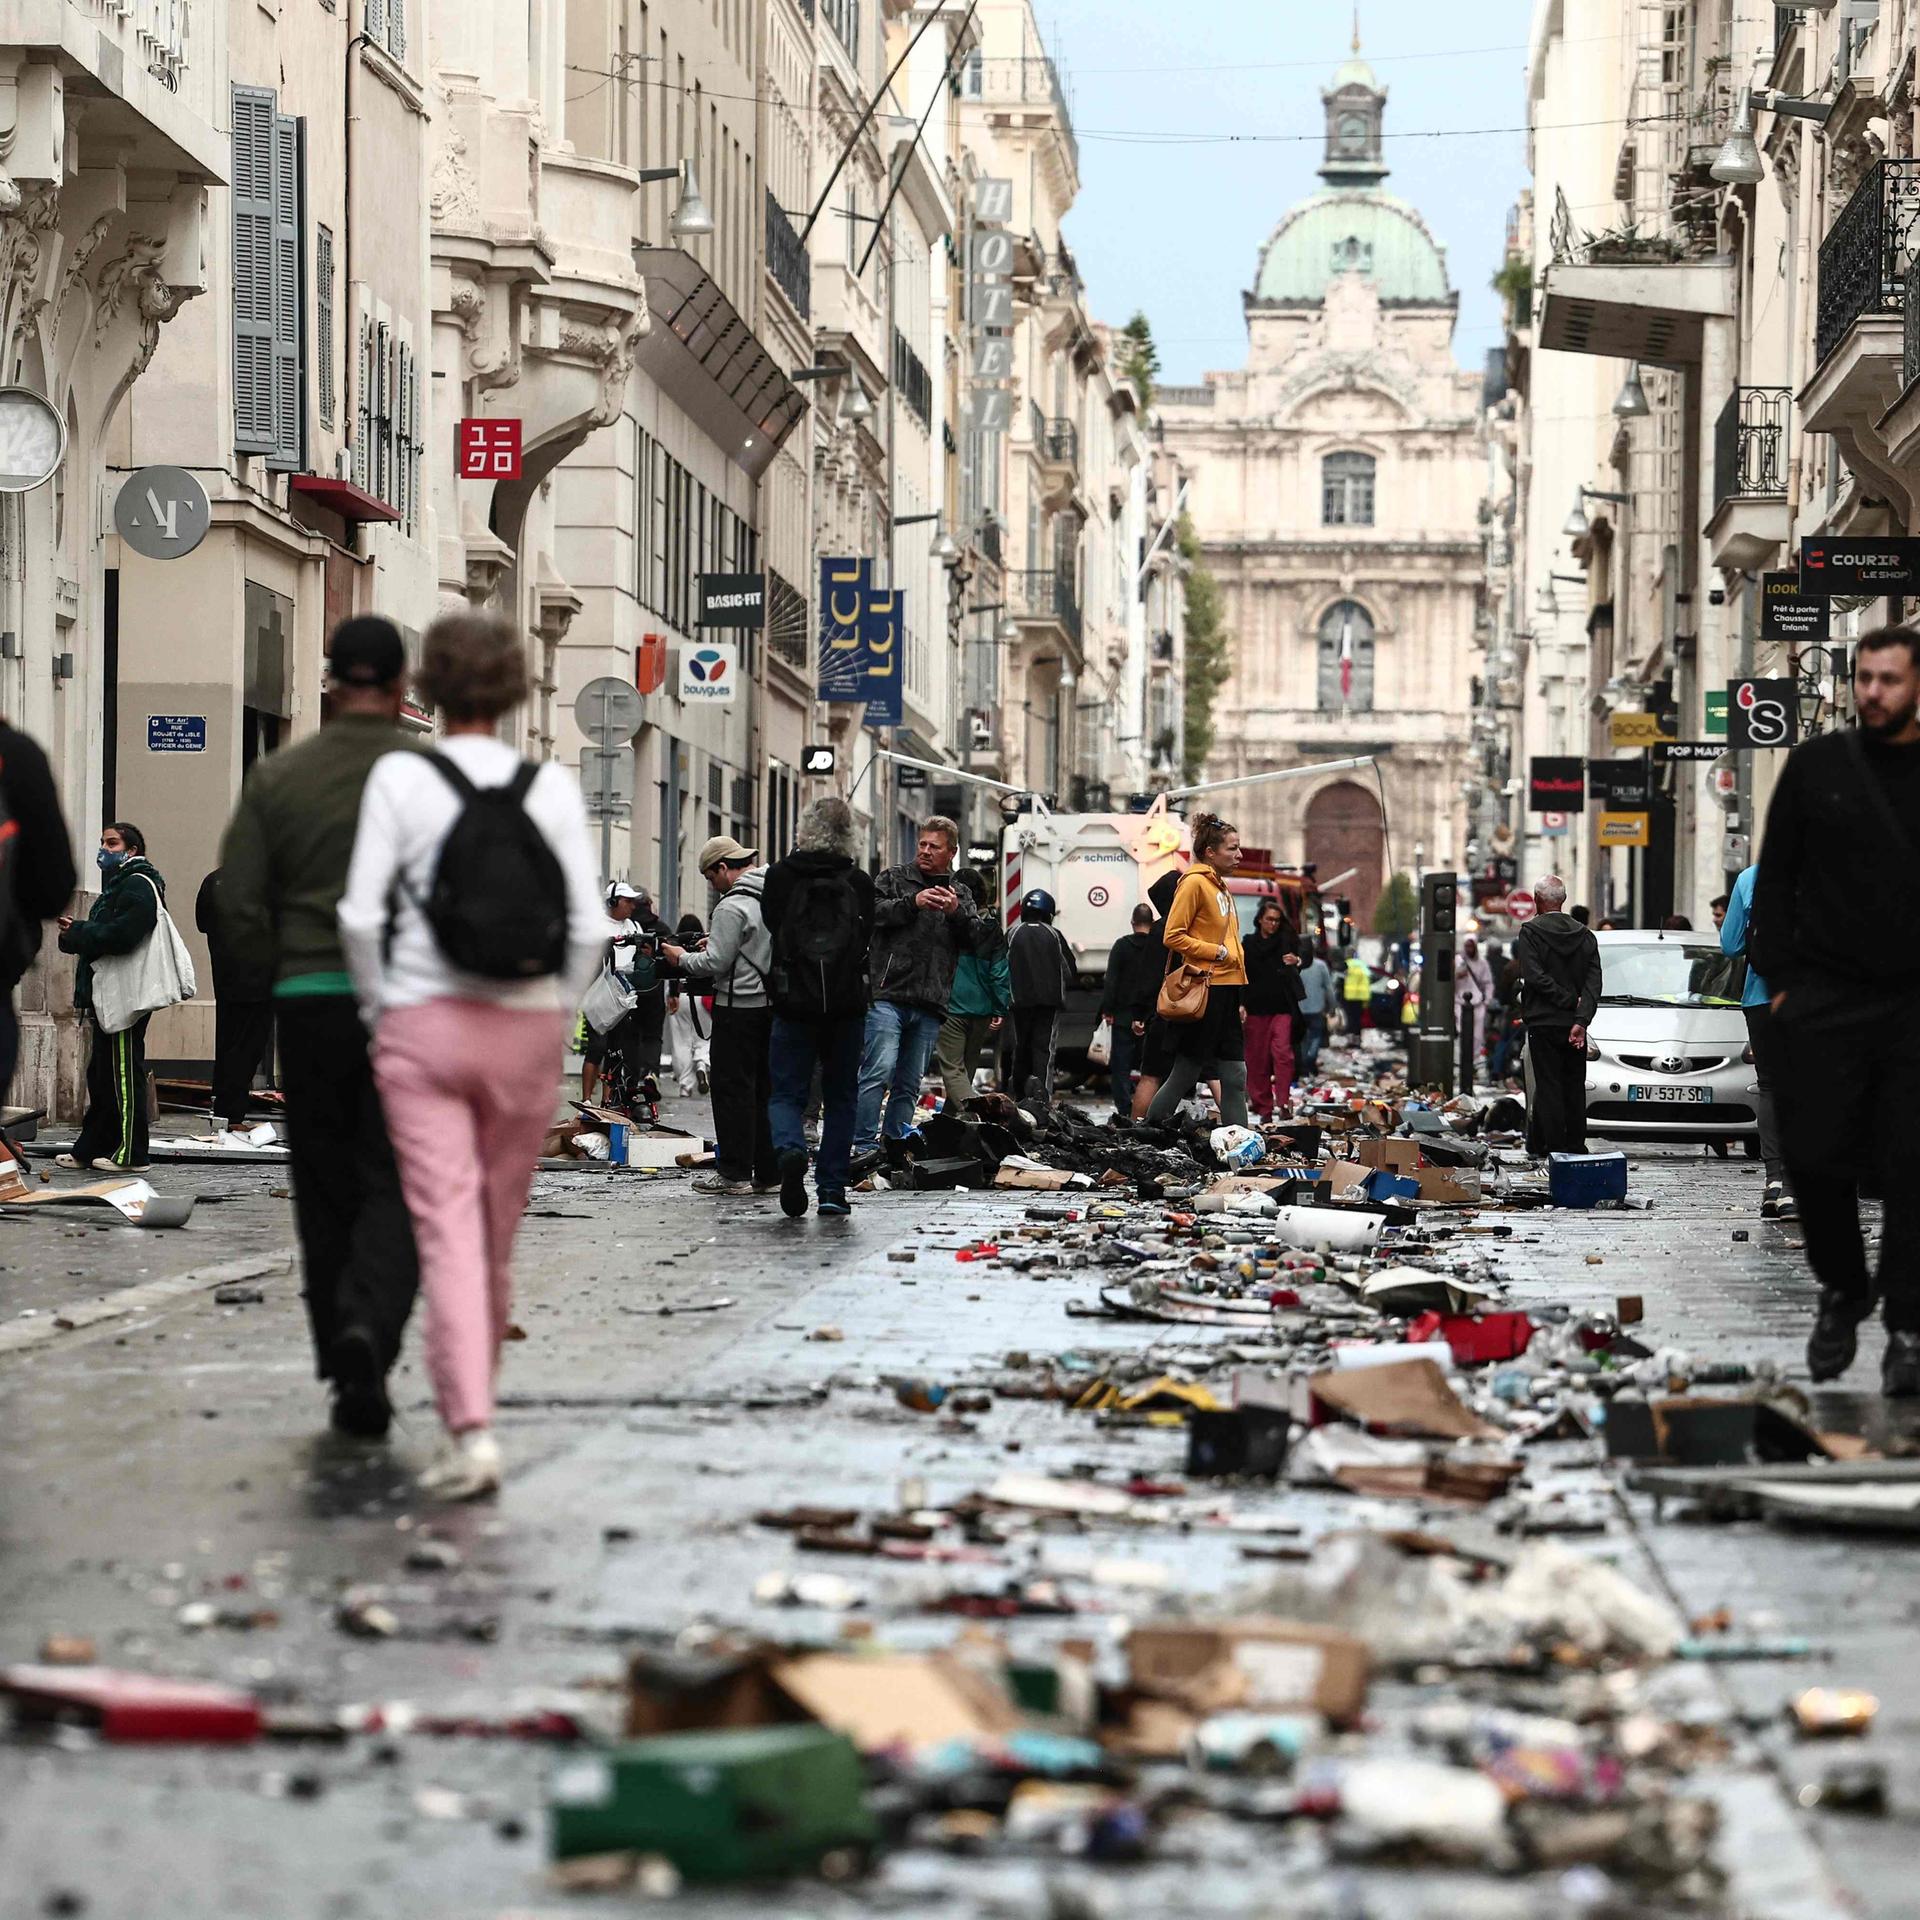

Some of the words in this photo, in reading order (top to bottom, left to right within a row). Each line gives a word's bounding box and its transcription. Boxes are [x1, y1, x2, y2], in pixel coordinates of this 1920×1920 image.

[977, 183, 1009, 428] HOTEL
[1831, 554, 1900, 566] COURIR
[1767, 584, 1799, 594] LOOK
[831, 556, 861, 650] LCL
[1796, 606, 1819, 614] porter
[1773, 614, 1818, 622] Chaussures
[868, 587, 894, 677] LCL
[1781, 623, 1809, 631] Enfants
[683, 683, 730, 697] bouygues
[1667, 746, 1691, 757] POP
[1084, 853, 1128, 862] schmidt
[1092, 891, 1104, 902] 25
